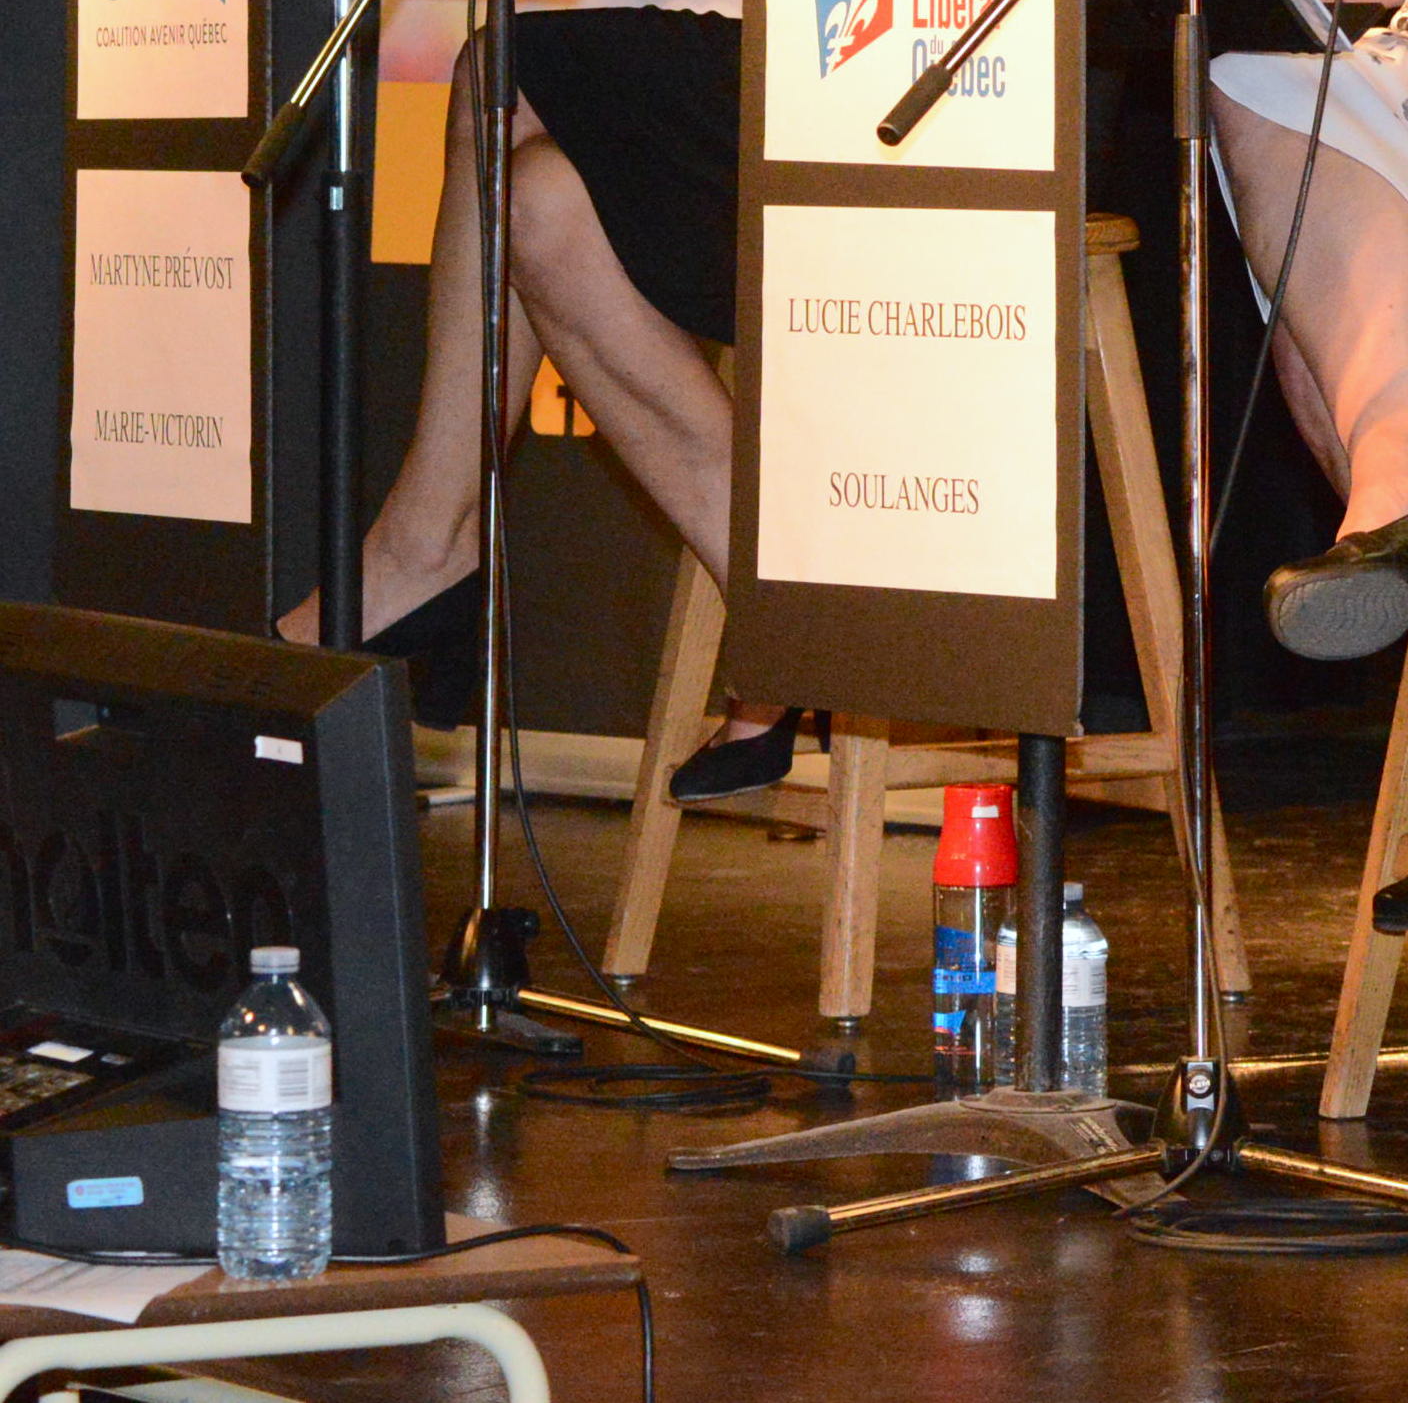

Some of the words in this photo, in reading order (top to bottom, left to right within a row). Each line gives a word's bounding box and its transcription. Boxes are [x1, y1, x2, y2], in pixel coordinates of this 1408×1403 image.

[96, 25, 147, 47] COALITION
[150, 23, 185, 46] AVENIR
[189, 19, 228, 50] QUÉBEC
[930, 35, 944, 55] du
[90, 253, 161, 289] MARTYNE
[164, 247, 233, 290] PRÉVOST
[788, 298, 861, 336] LUCIE
[868, 300, 1027, 341] CHARLEBOIS
[95, 409, 223, 449] MARIE-VICTORIN
[828, 471, 980, 515] SOULANGES
